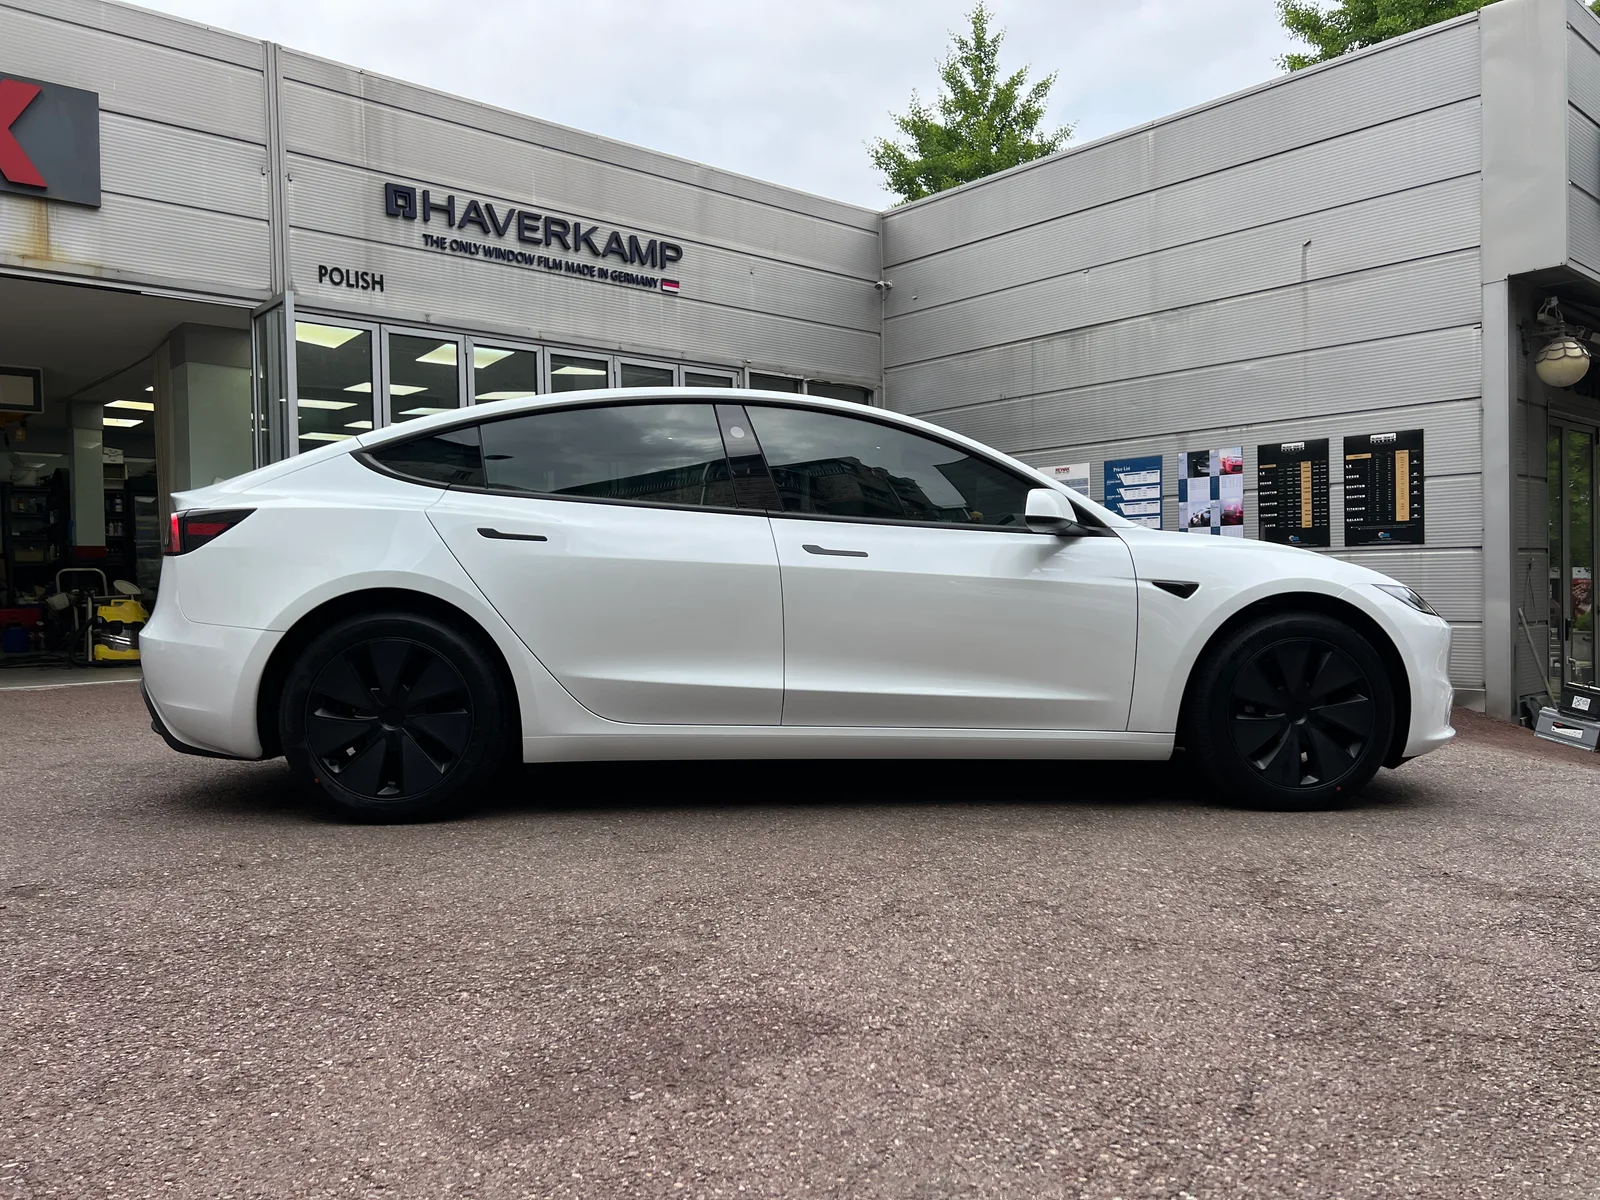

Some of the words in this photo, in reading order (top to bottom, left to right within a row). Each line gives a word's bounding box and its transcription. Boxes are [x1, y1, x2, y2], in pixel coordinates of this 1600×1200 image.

[422, 189, 683, 269] HAVERKAMP
[318, 264, 384, 293] POLISH
[422, 233, 447, 250] THE
[450, 239, 482, 256] ONLY
[483, 245, 536, 266] WINDOW
[537, 256, 563, 271] FILM
[565, 261, 596, 278] MADE
[598, 267, 609, 280] IN
[610, 270, 660, 289] GERMANY
